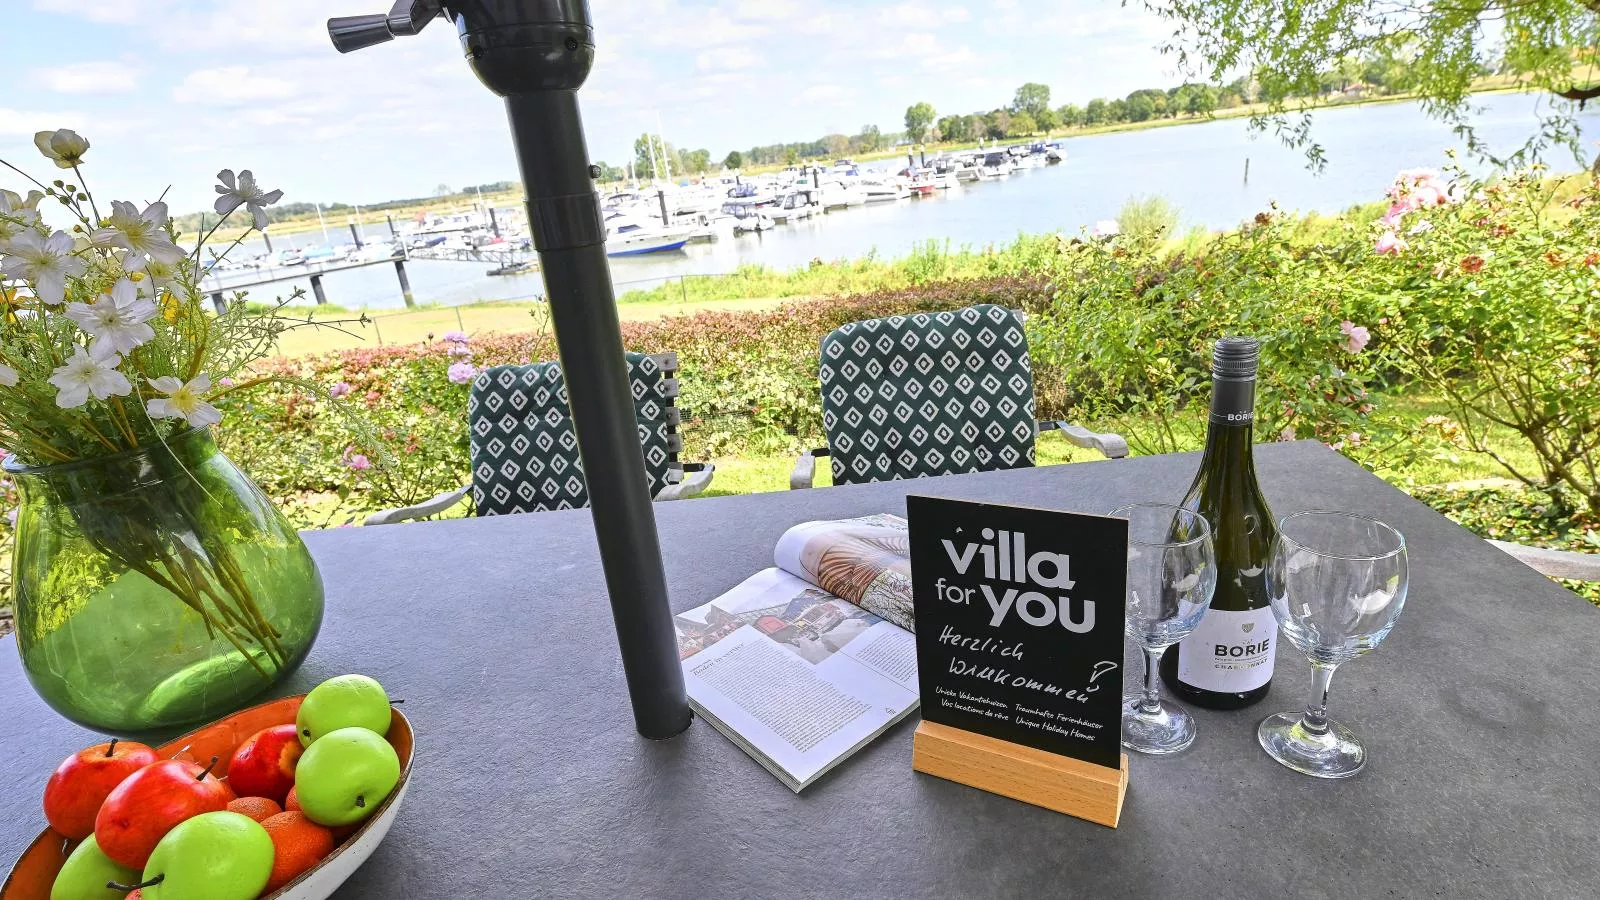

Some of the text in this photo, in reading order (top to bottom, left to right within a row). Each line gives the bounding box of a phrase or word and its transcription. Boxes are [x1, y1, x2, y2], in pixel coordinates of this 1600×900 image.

[941, 527, 1076, 590] villa
[935, 577, 1096, 634] for you
[939, 624, 1024, 661] Herzlich
[1214, 638, 1270, 657] BORIE
[1214, 658, 1268, 670] CHARONNAY
[941, 698, 954, 708] Vos
[954, 702, 985, 715] locations
[1015, 716, 1096, 741] Unique Holiday Homes
